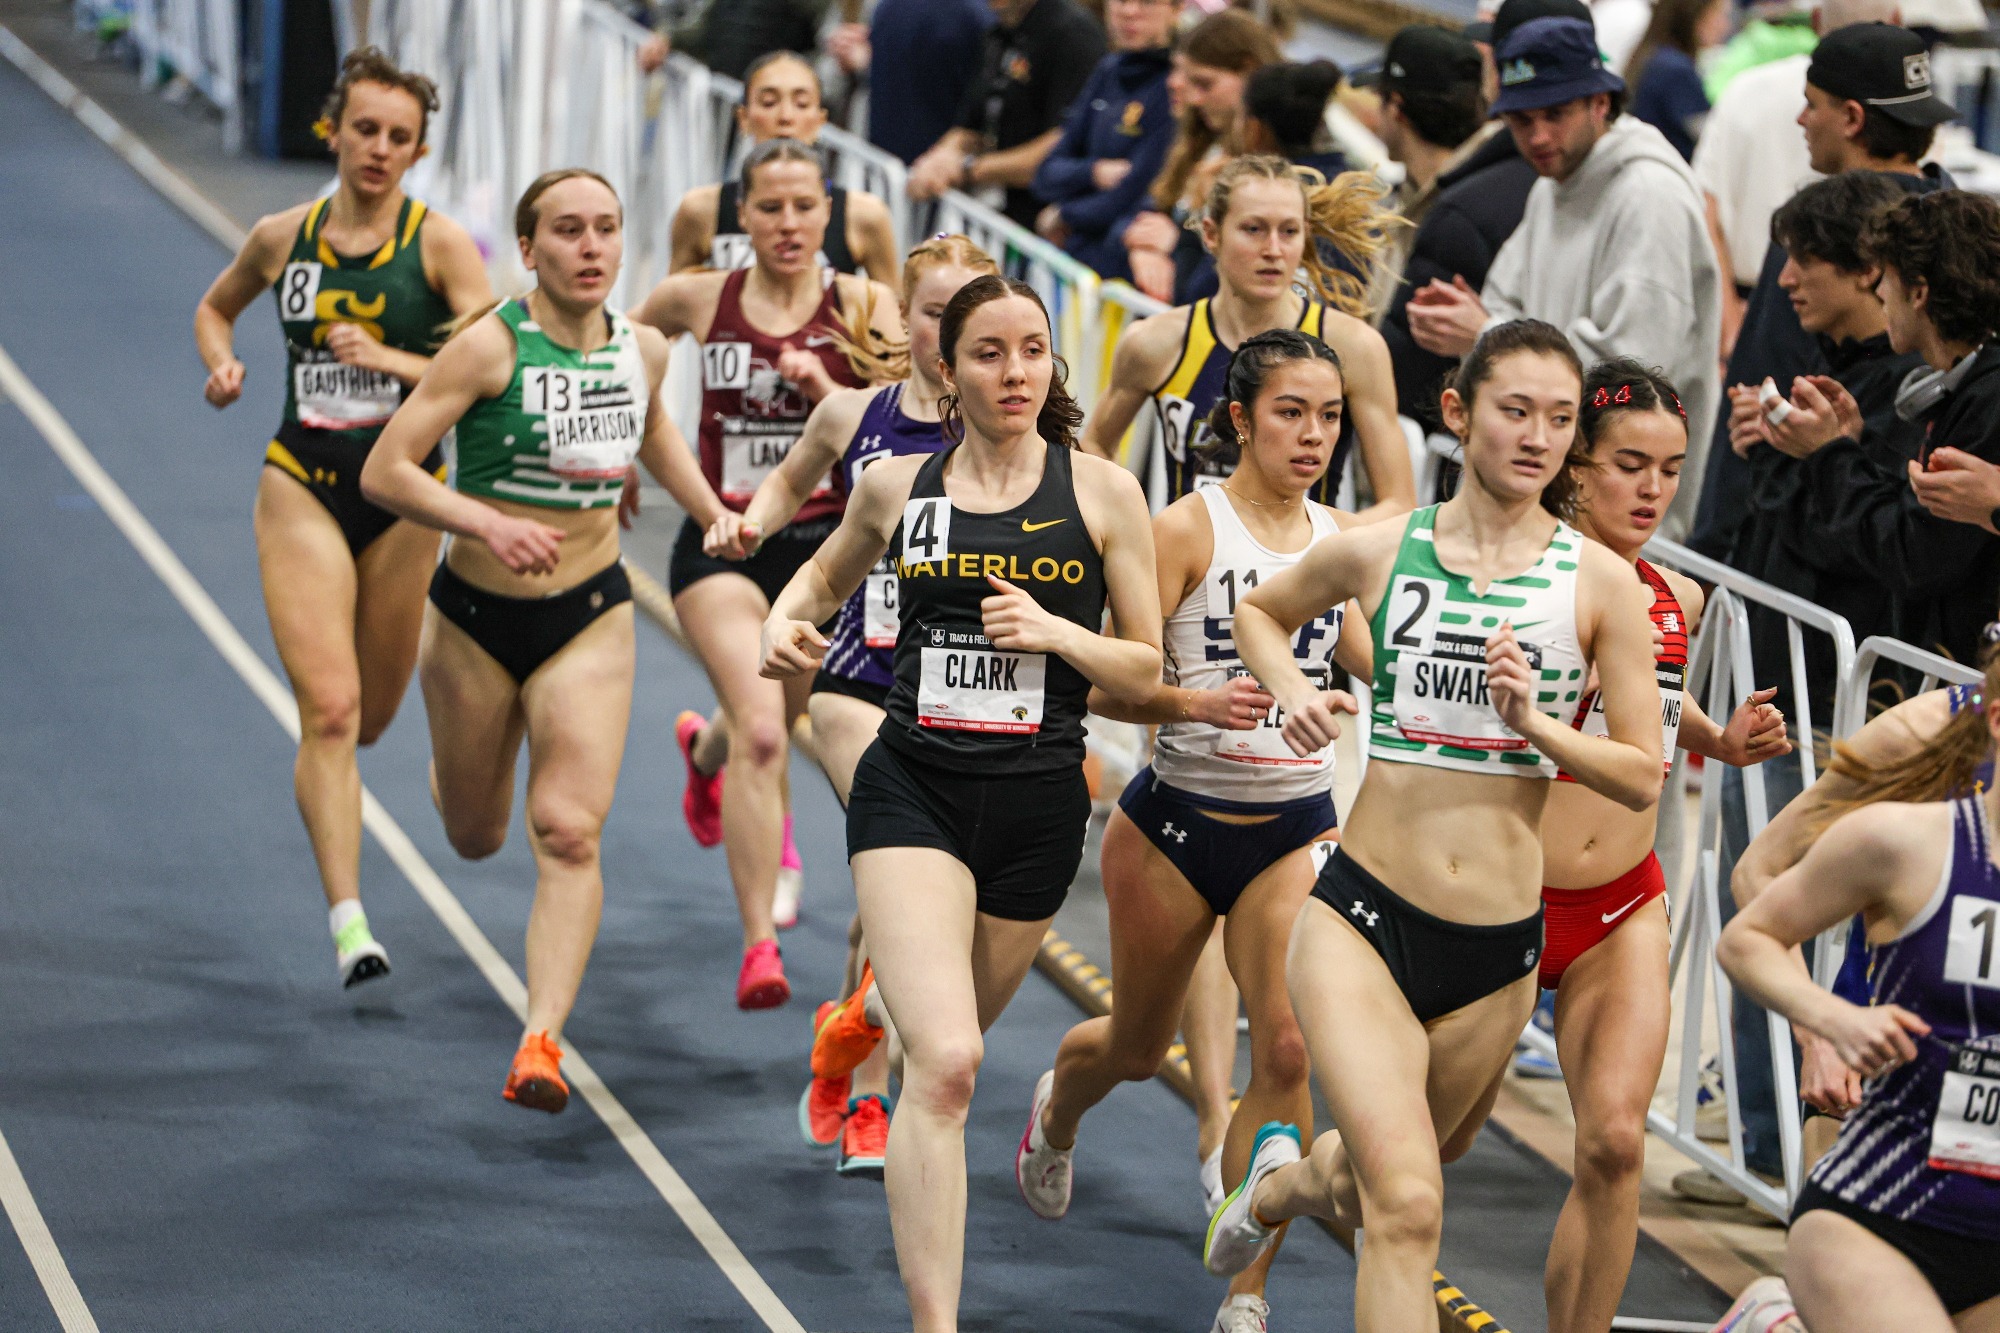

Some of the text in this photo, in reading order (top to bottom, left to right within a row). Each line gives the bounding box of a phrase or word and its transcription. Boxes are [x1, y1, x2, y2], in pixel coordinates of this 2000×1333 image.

[288, 268, 310, 315] 8
[707, 346, 739, 384] 10
[536, 372, 571, 412] 13
[555, 412, 637, 447] HARRISON
[908, 501, 939, 558] 4
[894, 553, 1085, 584] WATERLOO
[1392, 581, 1430, 648] 2
[949, 633, 968, 644] TRACK
[969, 635, 974, 644] &
[974, 635, 990, 645] FIELD
[945, 653, 1020, 692] CLARK
